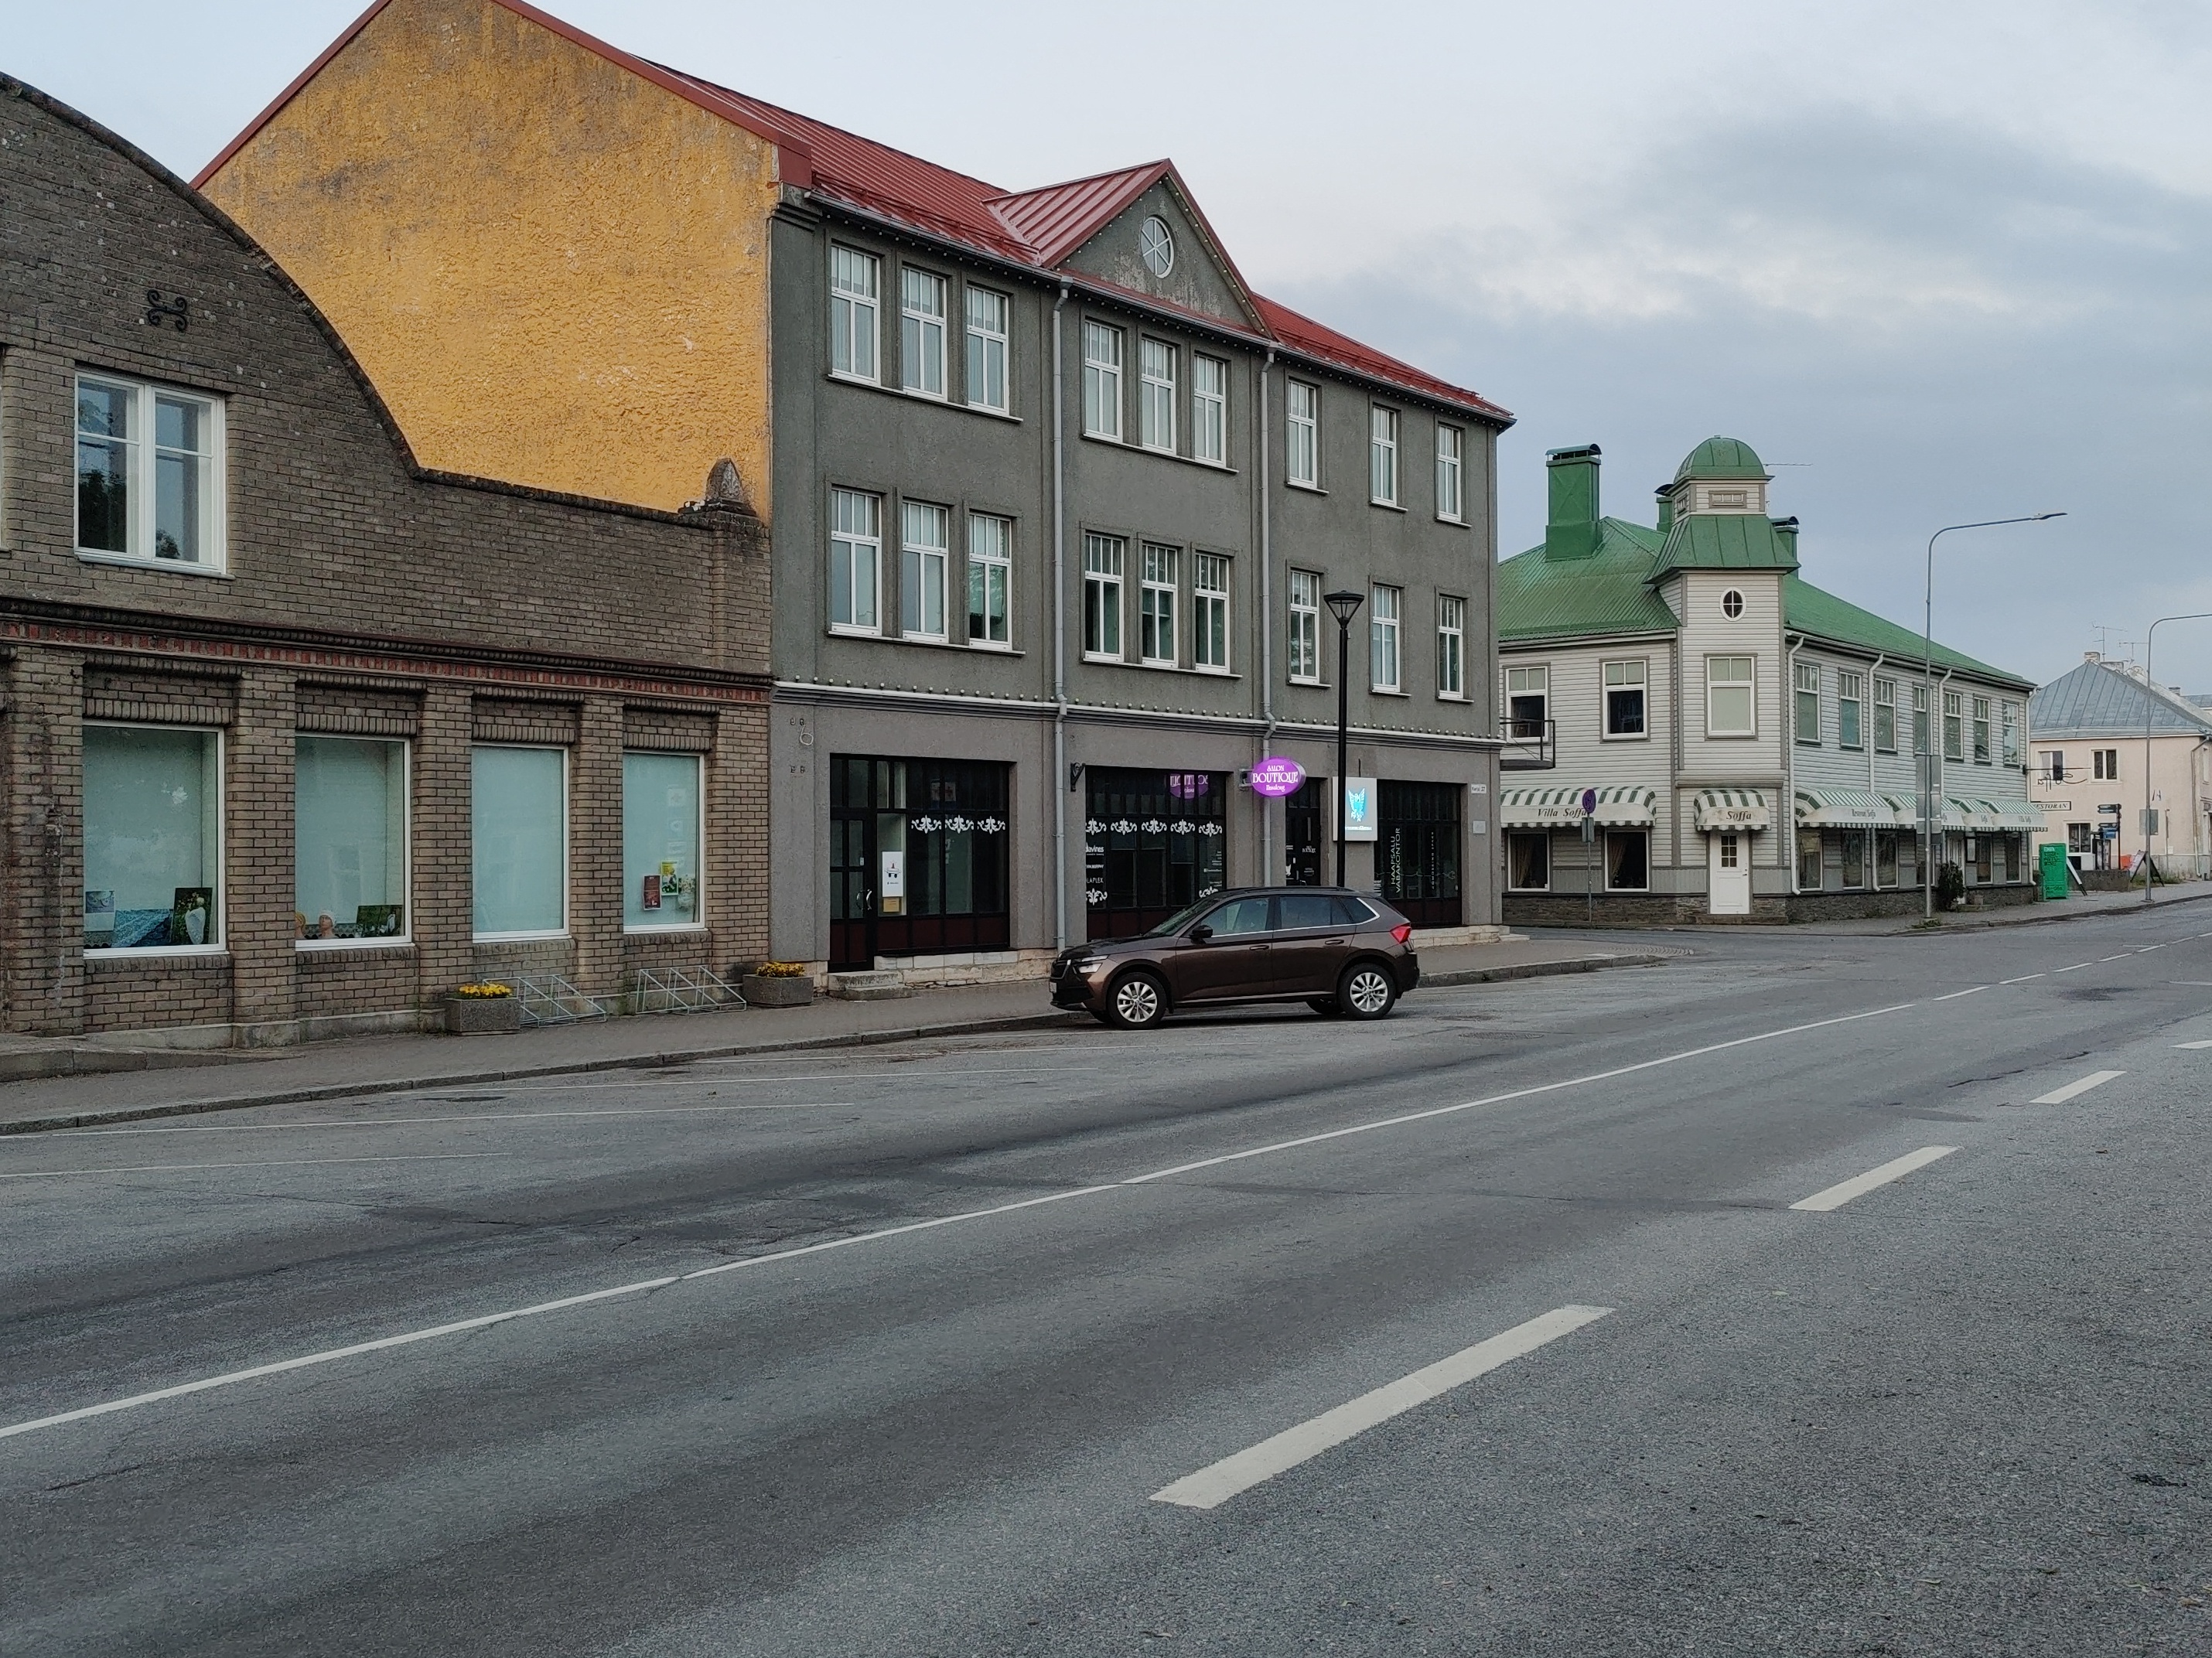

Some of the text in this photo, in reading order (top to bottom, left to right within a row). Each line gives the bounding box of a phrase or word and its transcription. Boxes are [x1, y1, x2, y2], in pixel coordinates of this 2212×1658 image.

[1252, 771, 1299, 784] BOUTIQUE
[1538, 807, 1586, 819] Villa Soffa
[1726, 810, 1752, 822] Soffa
